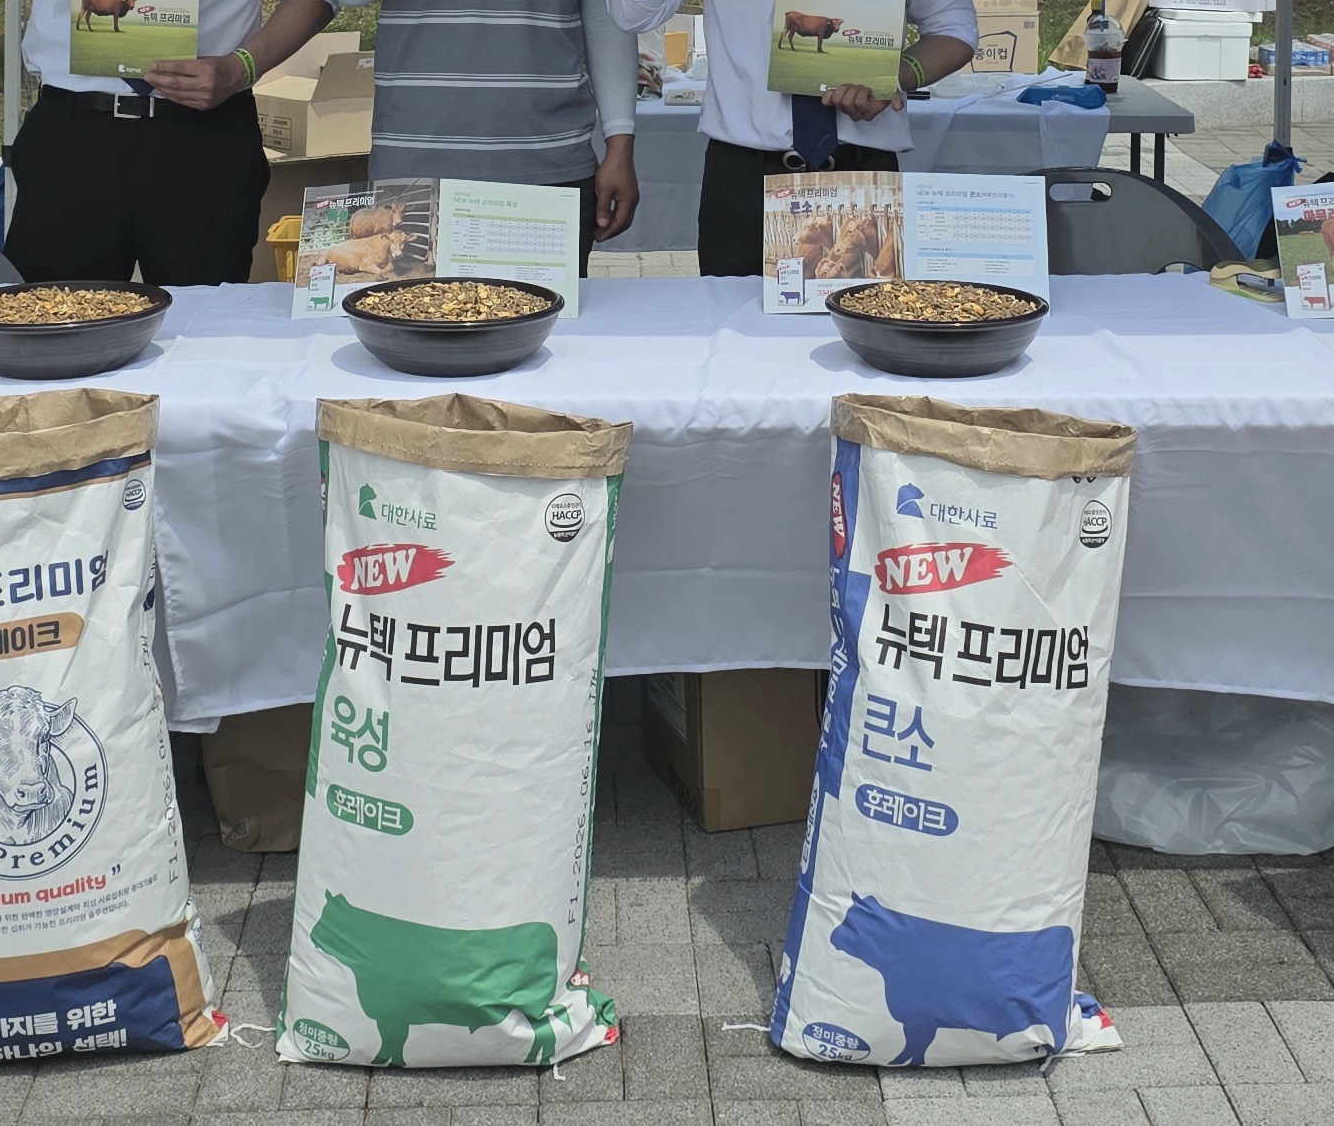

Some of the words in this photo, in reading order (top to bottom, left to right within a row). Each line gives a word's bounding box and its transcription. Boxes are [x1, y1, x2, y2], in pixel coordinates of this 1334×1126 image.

[975, 47, 1007, 60] 종이컵
[381, 504, 438, 532] 대한사료
[552, 509, 582, 521] HACCP
[930, 500, 998, 531] 대한사료
[351, 546, 418, 589] NEW
[882, 546, 974, 591] NEW
[337, 603, 396, 682] 뉴텍
[402, 618, 557, 689] 프리미엄
[875, 603, 947, 681] 뉴텍
[951, 624, 1089, 690] 프리미엄
[329, 694, 389, 773] 육성
[862, 692, 934, 773] 큰소
[334, 789, 402, 831] 후레이크
[864, 788, 947, 832] 후레이크
[35, 874, 107, 903] quality
[66, 999, 117, 1031] 위한
[71, 1028, 128, 1053] 선택!
[298, 1021, 339, 1046] 정미중량
[812, 1024, 860, 1049] 정미중량
[304, 1039, 335, 1061] 25kg
[817, 1043, 853, 1061] 25kg
